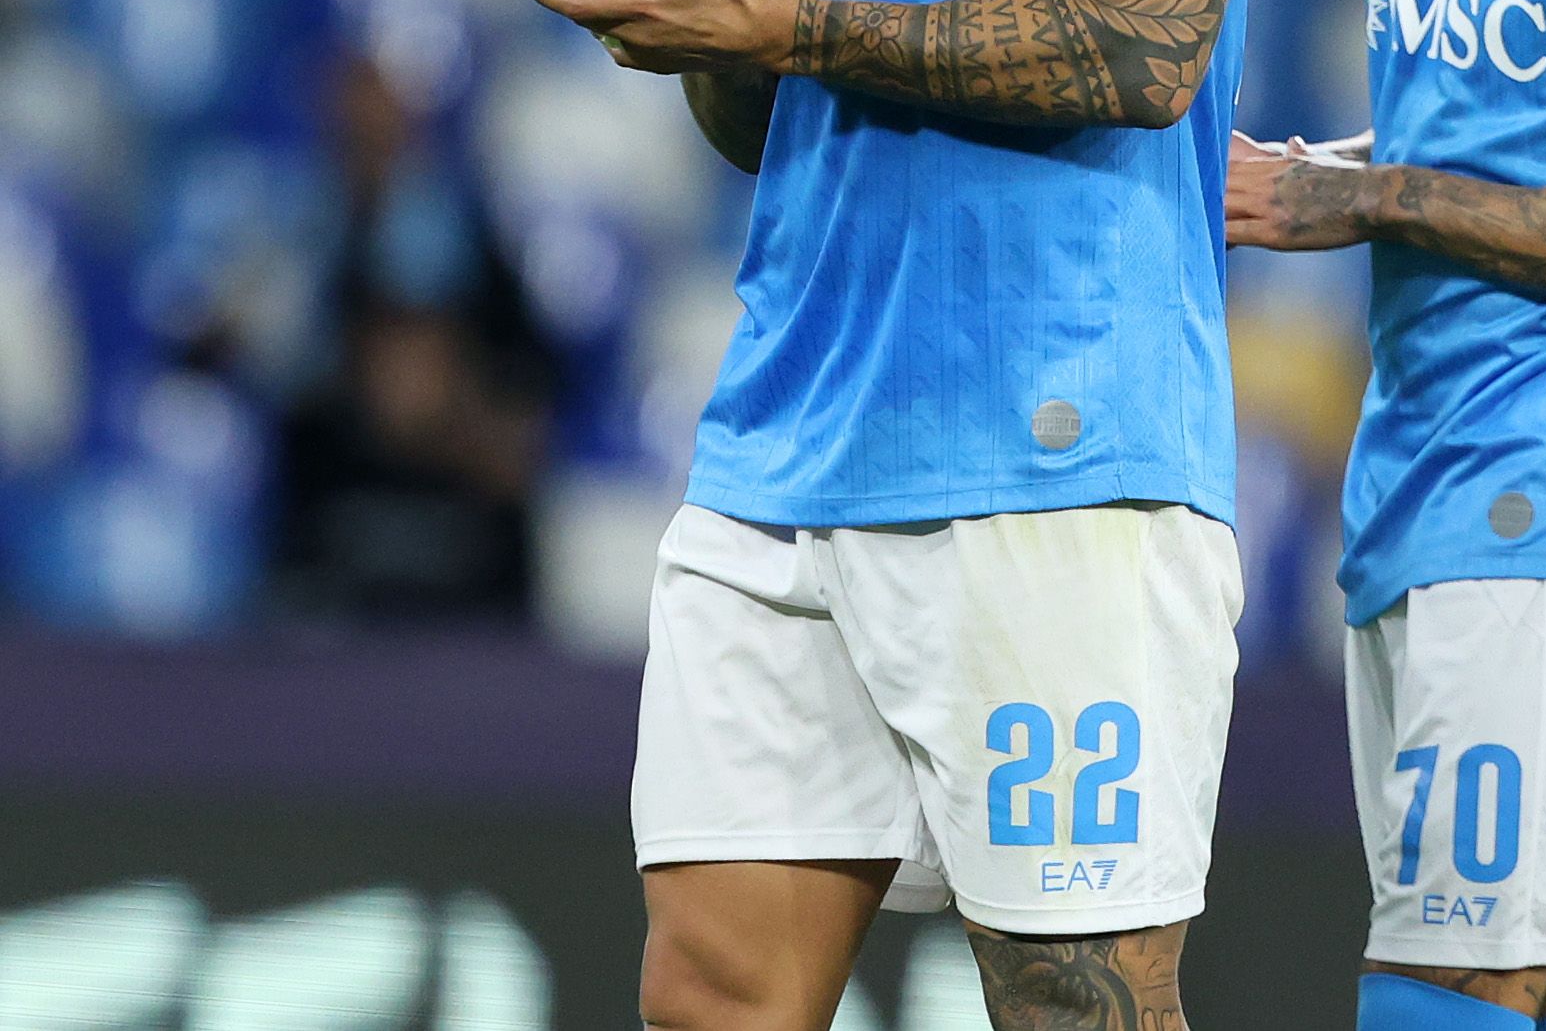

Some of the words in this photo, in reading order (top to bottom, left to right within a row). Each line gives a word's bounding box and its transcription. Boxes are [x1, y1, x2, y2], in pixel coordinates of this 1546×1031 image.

[985, 700, 1141, 847] 22
[1393, 742, 1523, 886] 70
[1041, 859, 1119, 893] EA7
[1422, 894, 1499, 927] EA7
